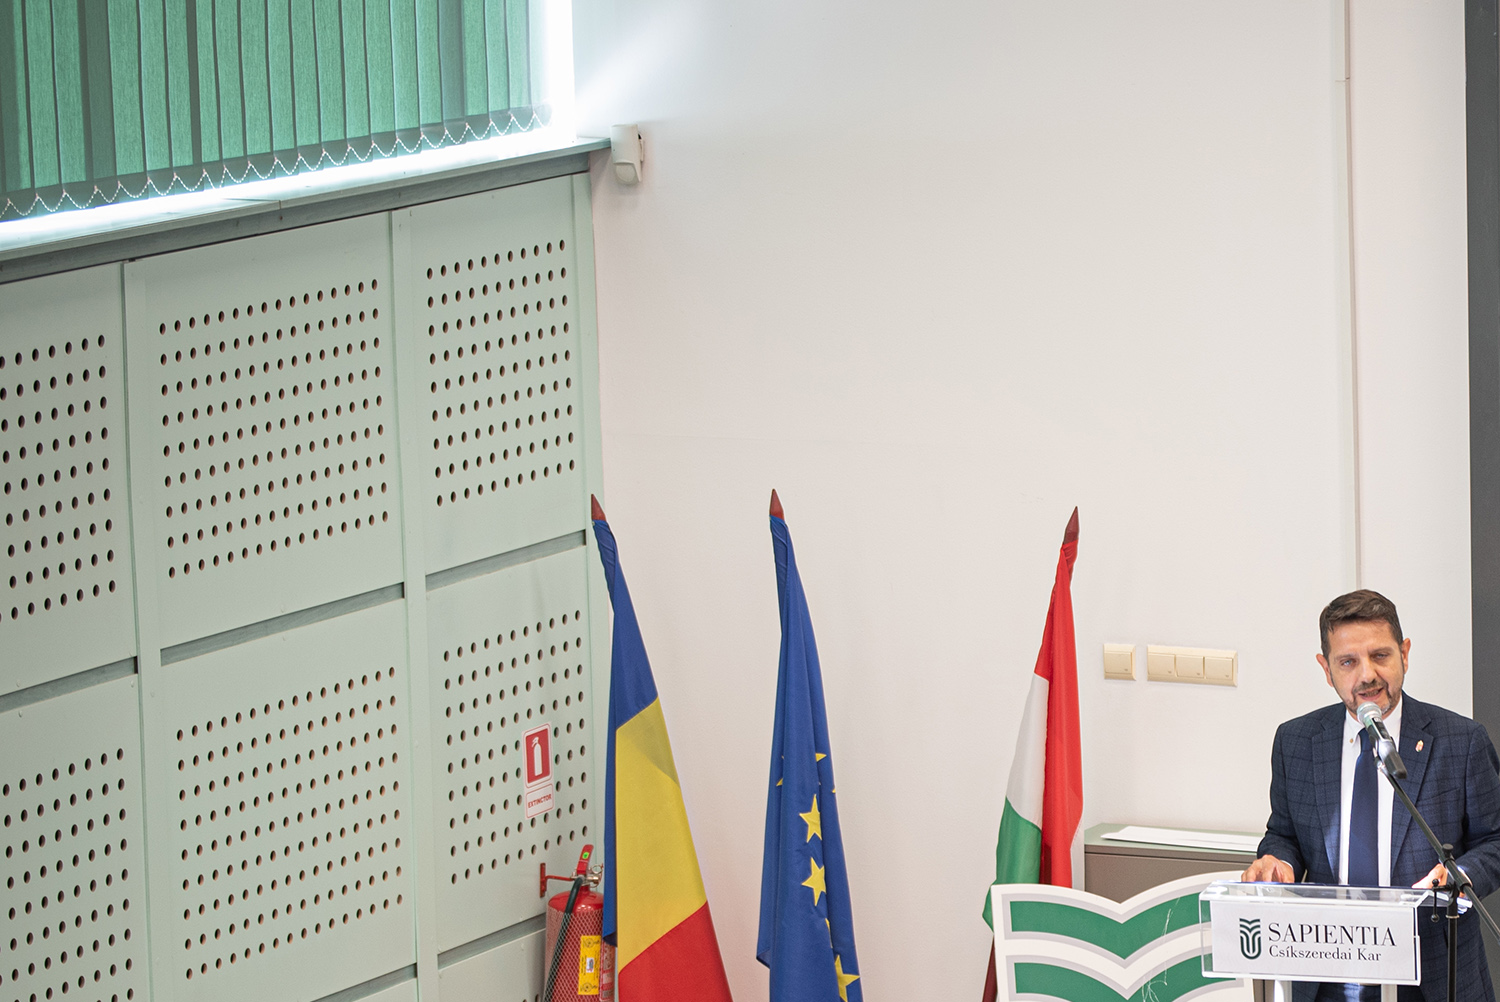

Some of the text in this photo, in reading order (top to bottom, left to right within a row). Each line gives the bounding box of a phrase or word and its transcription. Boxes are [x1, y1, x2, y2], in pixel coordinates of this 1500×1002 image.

[528, 794, 552, 808] EXTINCTOR
[1267, 922, 1397, 947] SAPIENTIA
[1268, 945, 1383, 963] Csíkszeredai Kar
